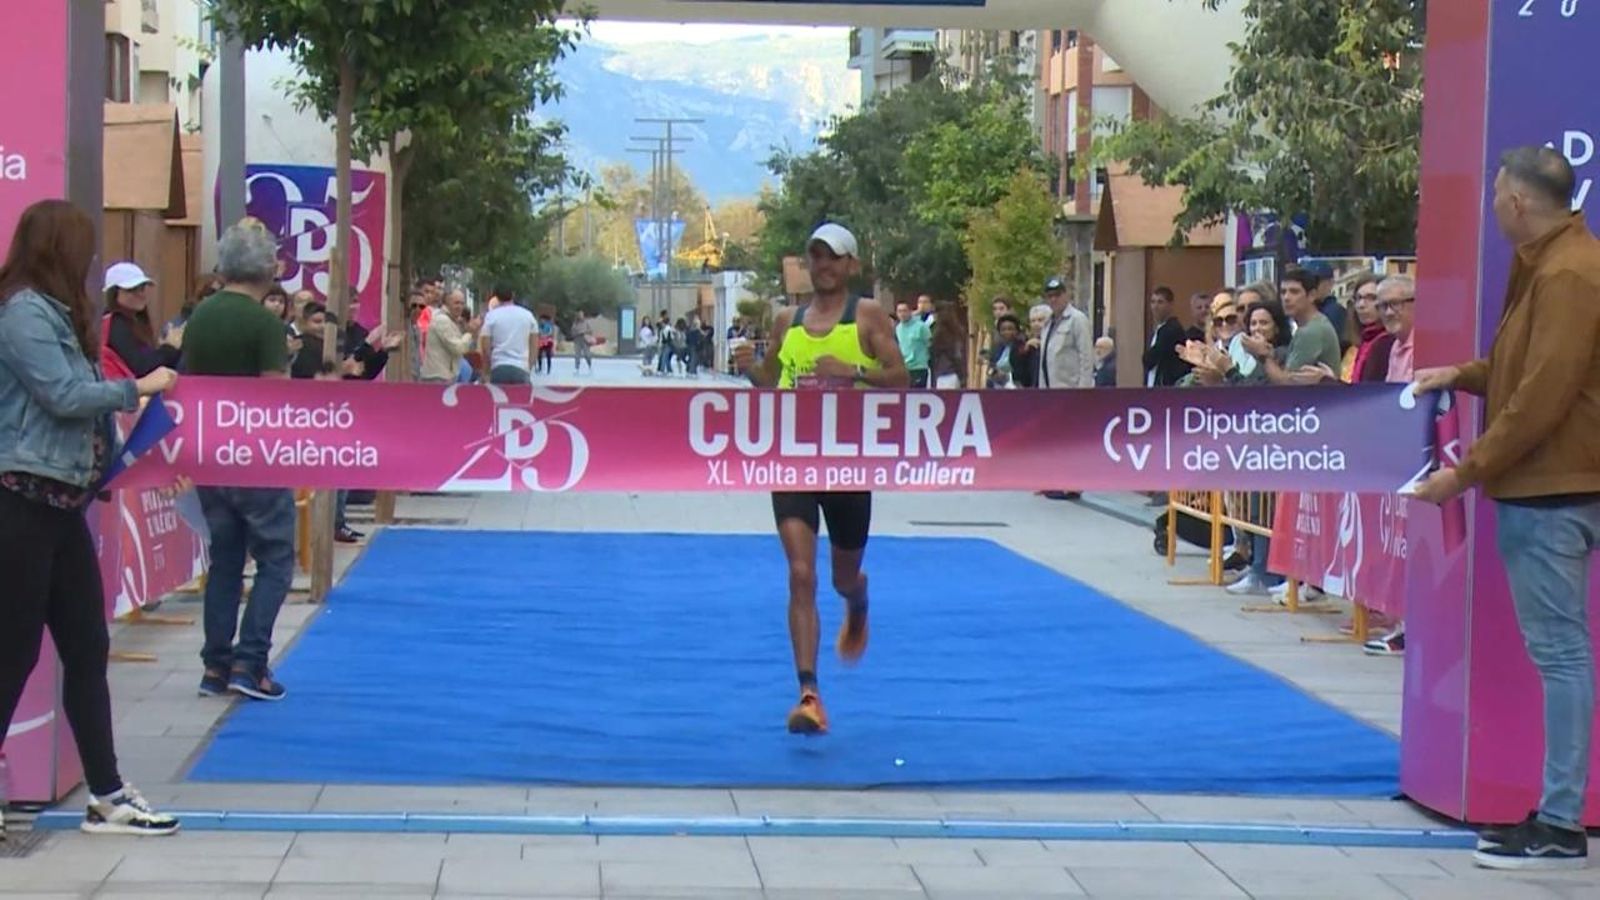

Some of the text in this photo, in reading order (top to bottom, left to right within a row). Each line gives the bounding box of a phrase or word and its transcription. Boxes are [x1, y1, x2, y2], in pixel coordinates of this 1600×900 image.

[216, 400, 354, 434] Diputació
[688, 391, 993, 458] CULLERA
[1183, 406, 1320, 440] Diputació
[215, 438, 379, 467] de València
[1182, 443, 1346, 471] de València
[707, 461, 975, 489] XL Volta a peu a Cullera
